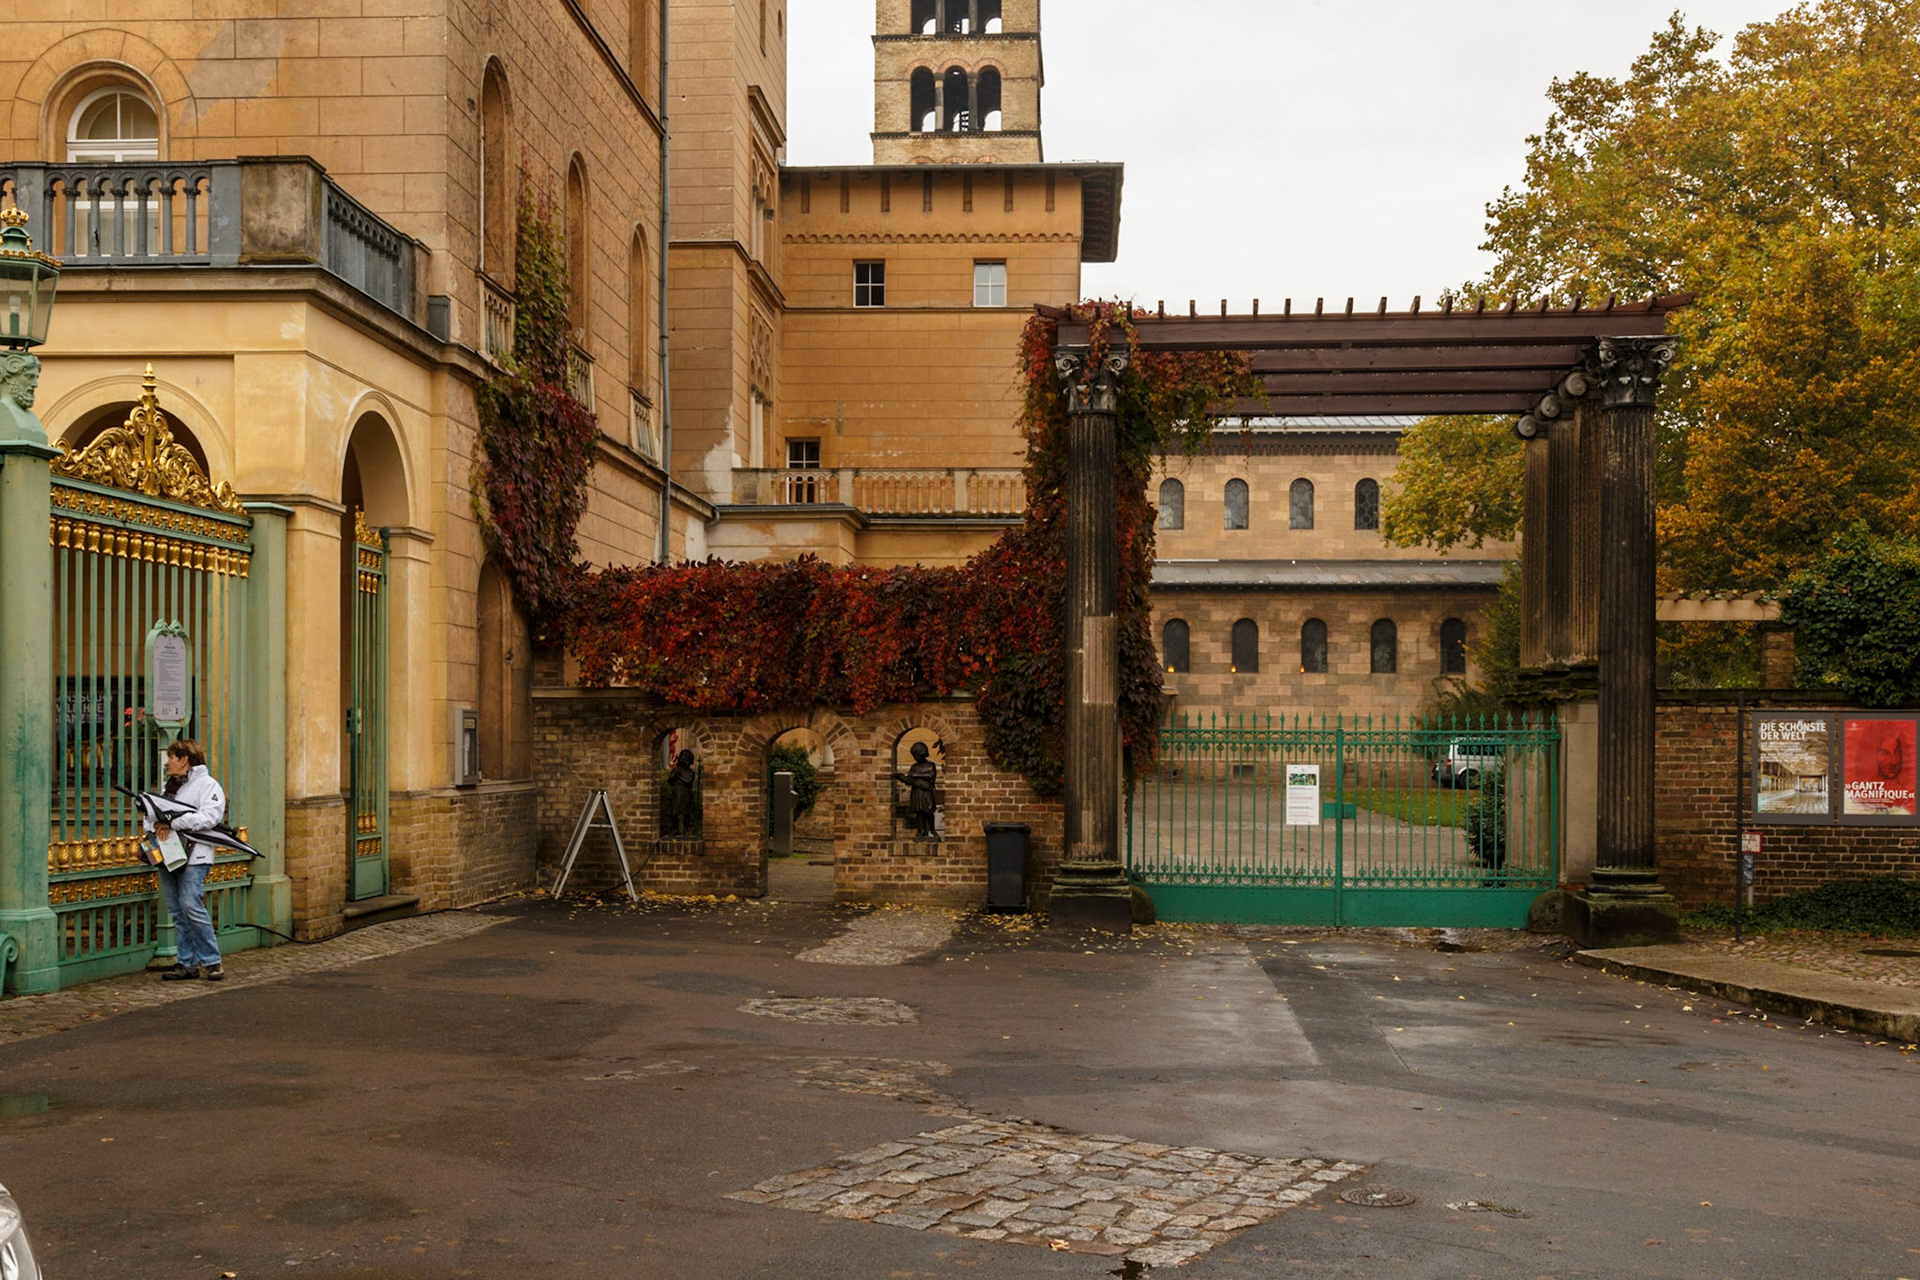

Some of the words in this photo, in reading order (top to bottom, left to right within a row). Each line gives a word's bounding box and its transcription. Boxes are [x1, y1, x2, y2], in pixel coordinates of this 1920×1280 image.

[1760, 722, 1776, 732] DIE
[1779, 721, 1827, 732] SCHÖNSTE
[1760, 731, 1779, 740] DER
[1781, 731, 1806, 740] WELT
